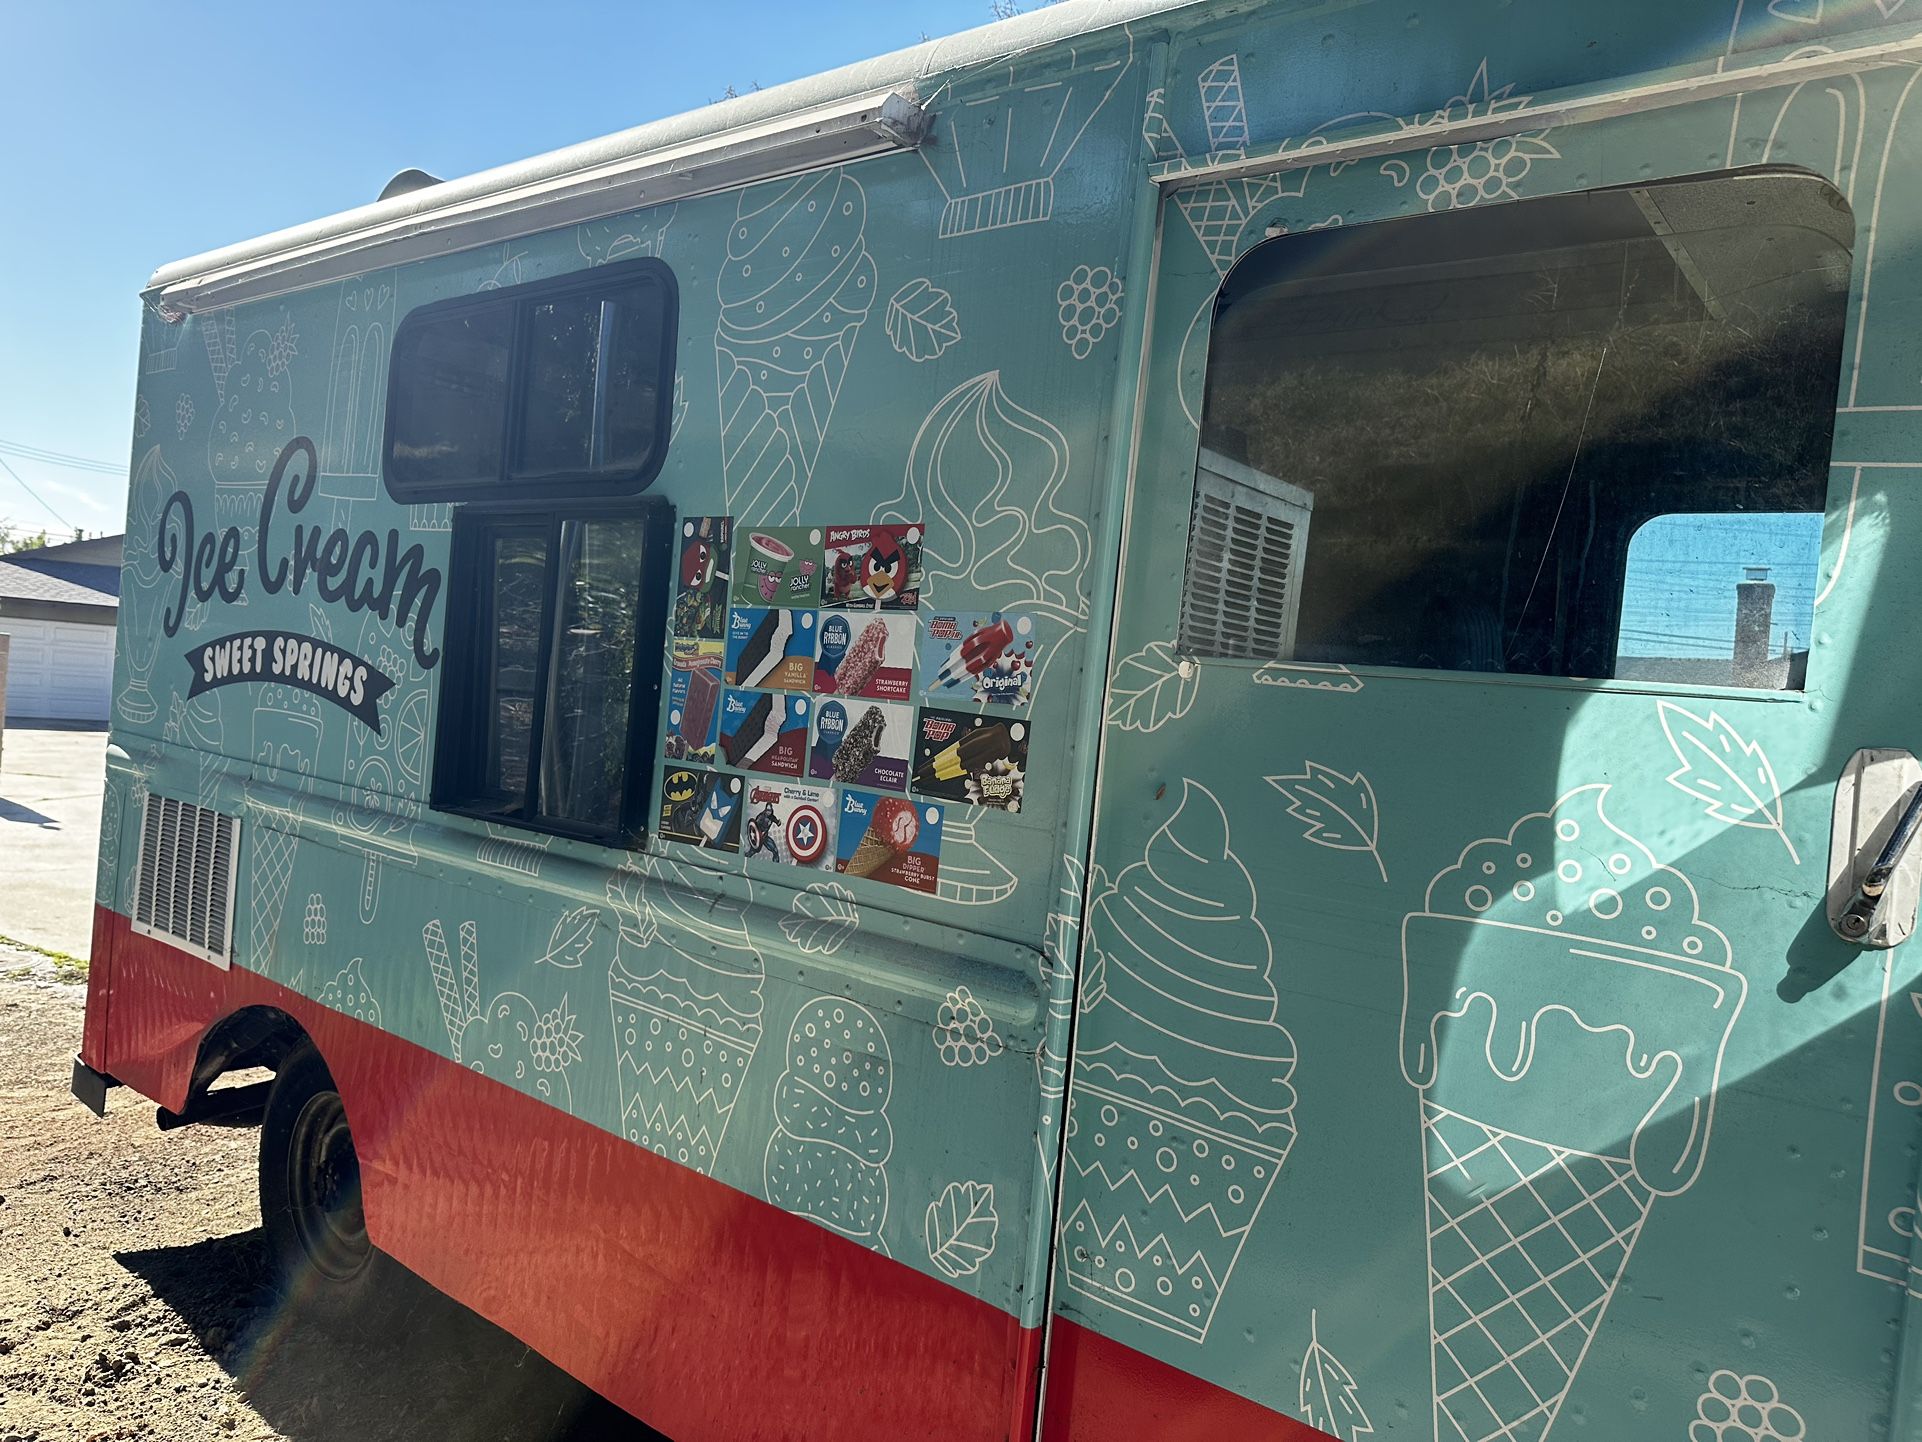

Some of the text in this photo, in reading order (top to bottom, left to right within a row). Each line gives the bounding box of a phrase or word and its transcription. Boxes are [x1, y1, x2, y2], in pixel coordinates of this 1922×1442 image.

[830, 529, 870, 542] ANGRY BIRDS
[158, 436, 441, 670] Ice Cream
[751, 560, 767, 570] JOLLY
[790, 575, 809, 587] JOLLY
[791, 583, 810, 591] rancher
[823, 632, 847, 645] RIBBON
[203, 636, 367, 706] SWEET SPRINGS
[789, 663, 803, 671] BIG
[875, 679, 908, 687] STRAWBERRY
[983, 675, 1022, 690] Original
[825, 711, 839, 719] BLUE
[820, 717, 844, 732] RIBBON
[778, 746, 793, 755] BIG
[771, 761, 798, 769] SANDWICH
[874, 768, 904, 778] CHOCOLATE
[980, 774, 1012, 787] Banana
[784, 787, 801, 796] Cherry
[807, 790, 820, 798] Lime
[983, 784, 1012, 798] Fudge
[907, 855, 921, 865] BIG
[891, 867, 920, 878] STRAWBERRY
[902, 863, 924, 873] DIPPER
[904, 876, 920, 884] CONE
